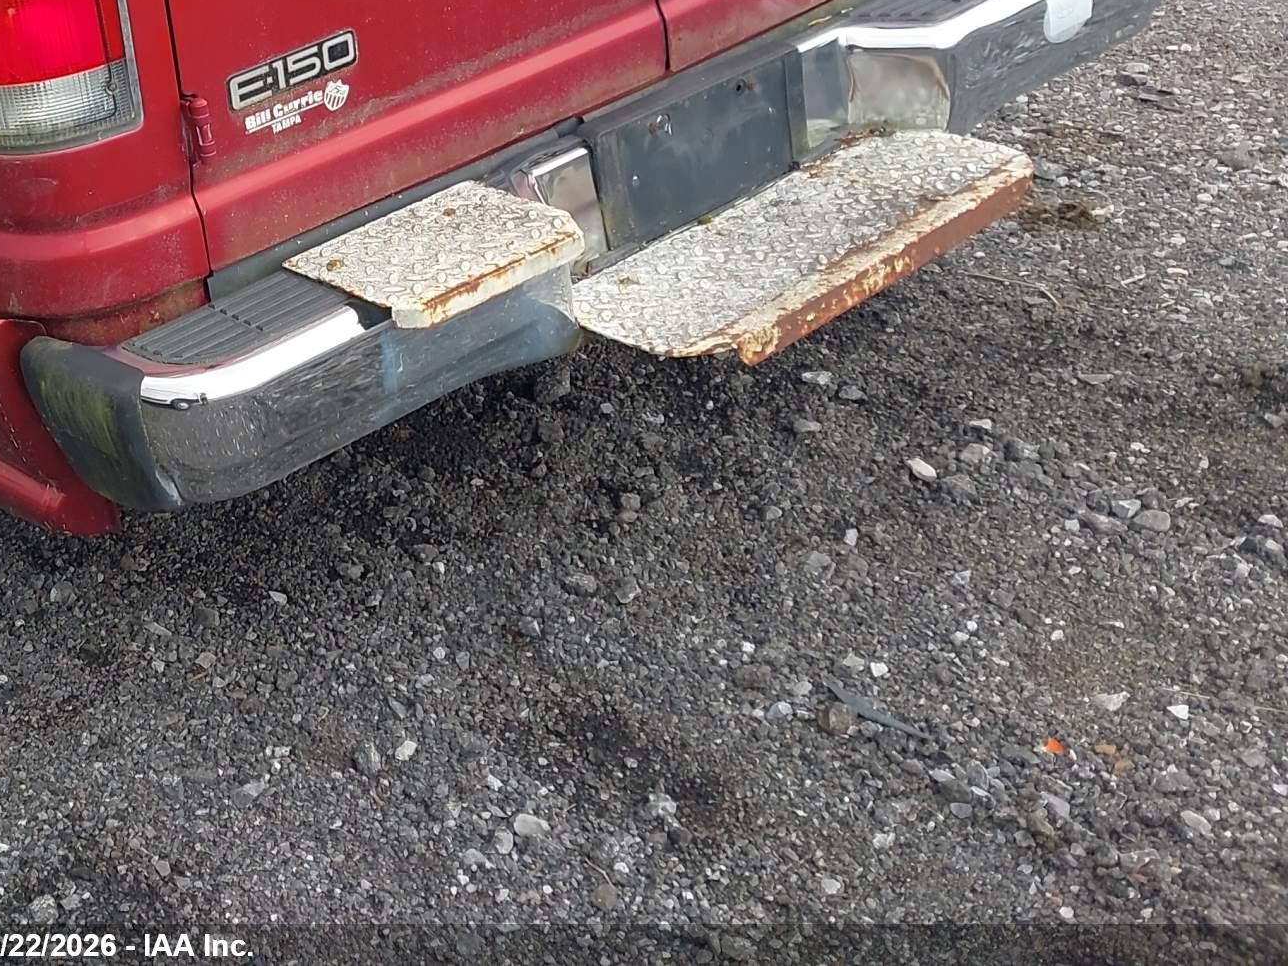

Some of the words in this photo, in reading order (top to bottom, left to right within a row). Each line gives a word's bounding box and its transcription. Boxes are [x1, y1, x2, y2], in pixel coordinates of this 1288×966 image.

[245, 109, 271, 130] Bill
[273, 90, 323, 118] Currie
[271, 114, 302, 135] TAMPA
